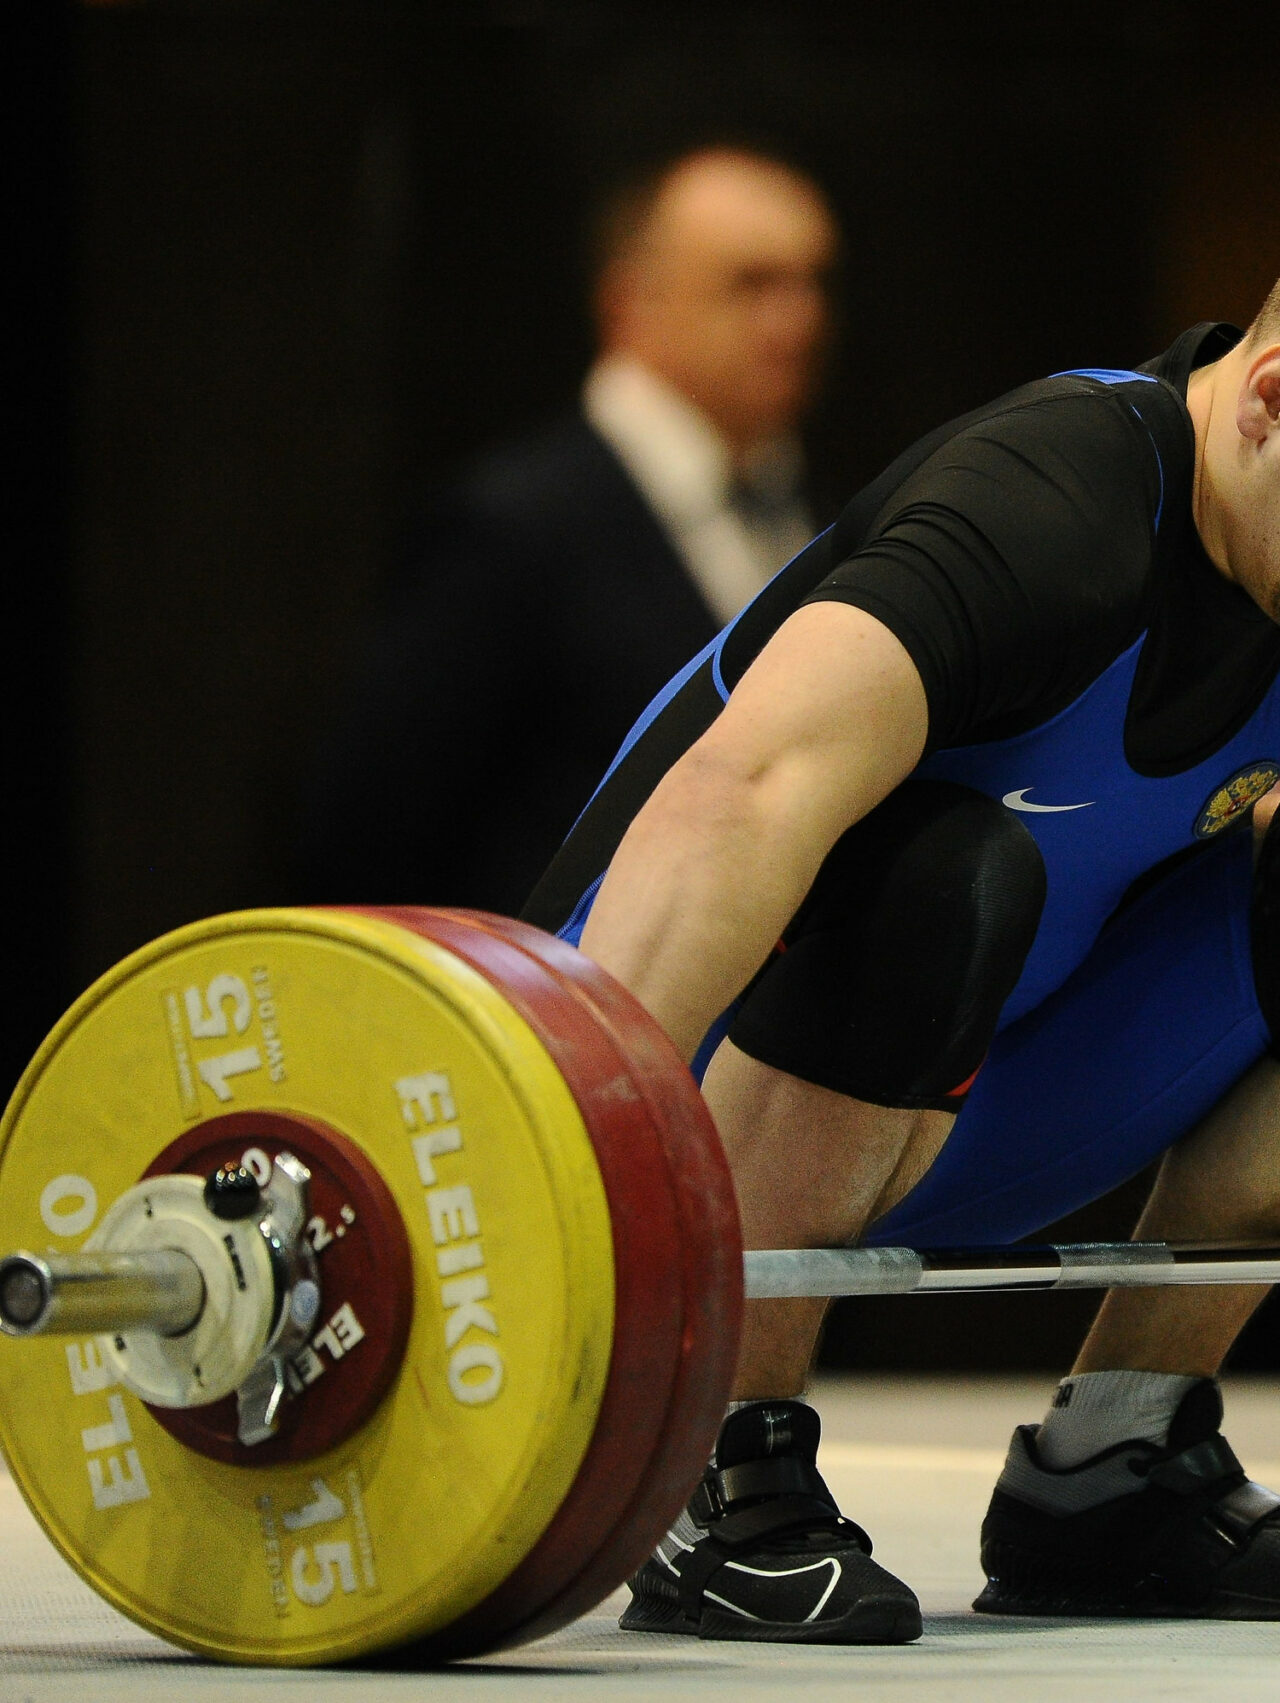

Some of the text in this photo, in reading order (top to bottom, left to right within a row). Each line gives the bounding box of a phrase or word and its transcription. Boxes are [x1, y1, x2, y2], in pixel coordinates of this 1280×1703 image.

[184, 973, 262, 1103] 15
[394, 1070, 505, 1408] ELEIKO
[282, 1476, 358, 1608] 15
